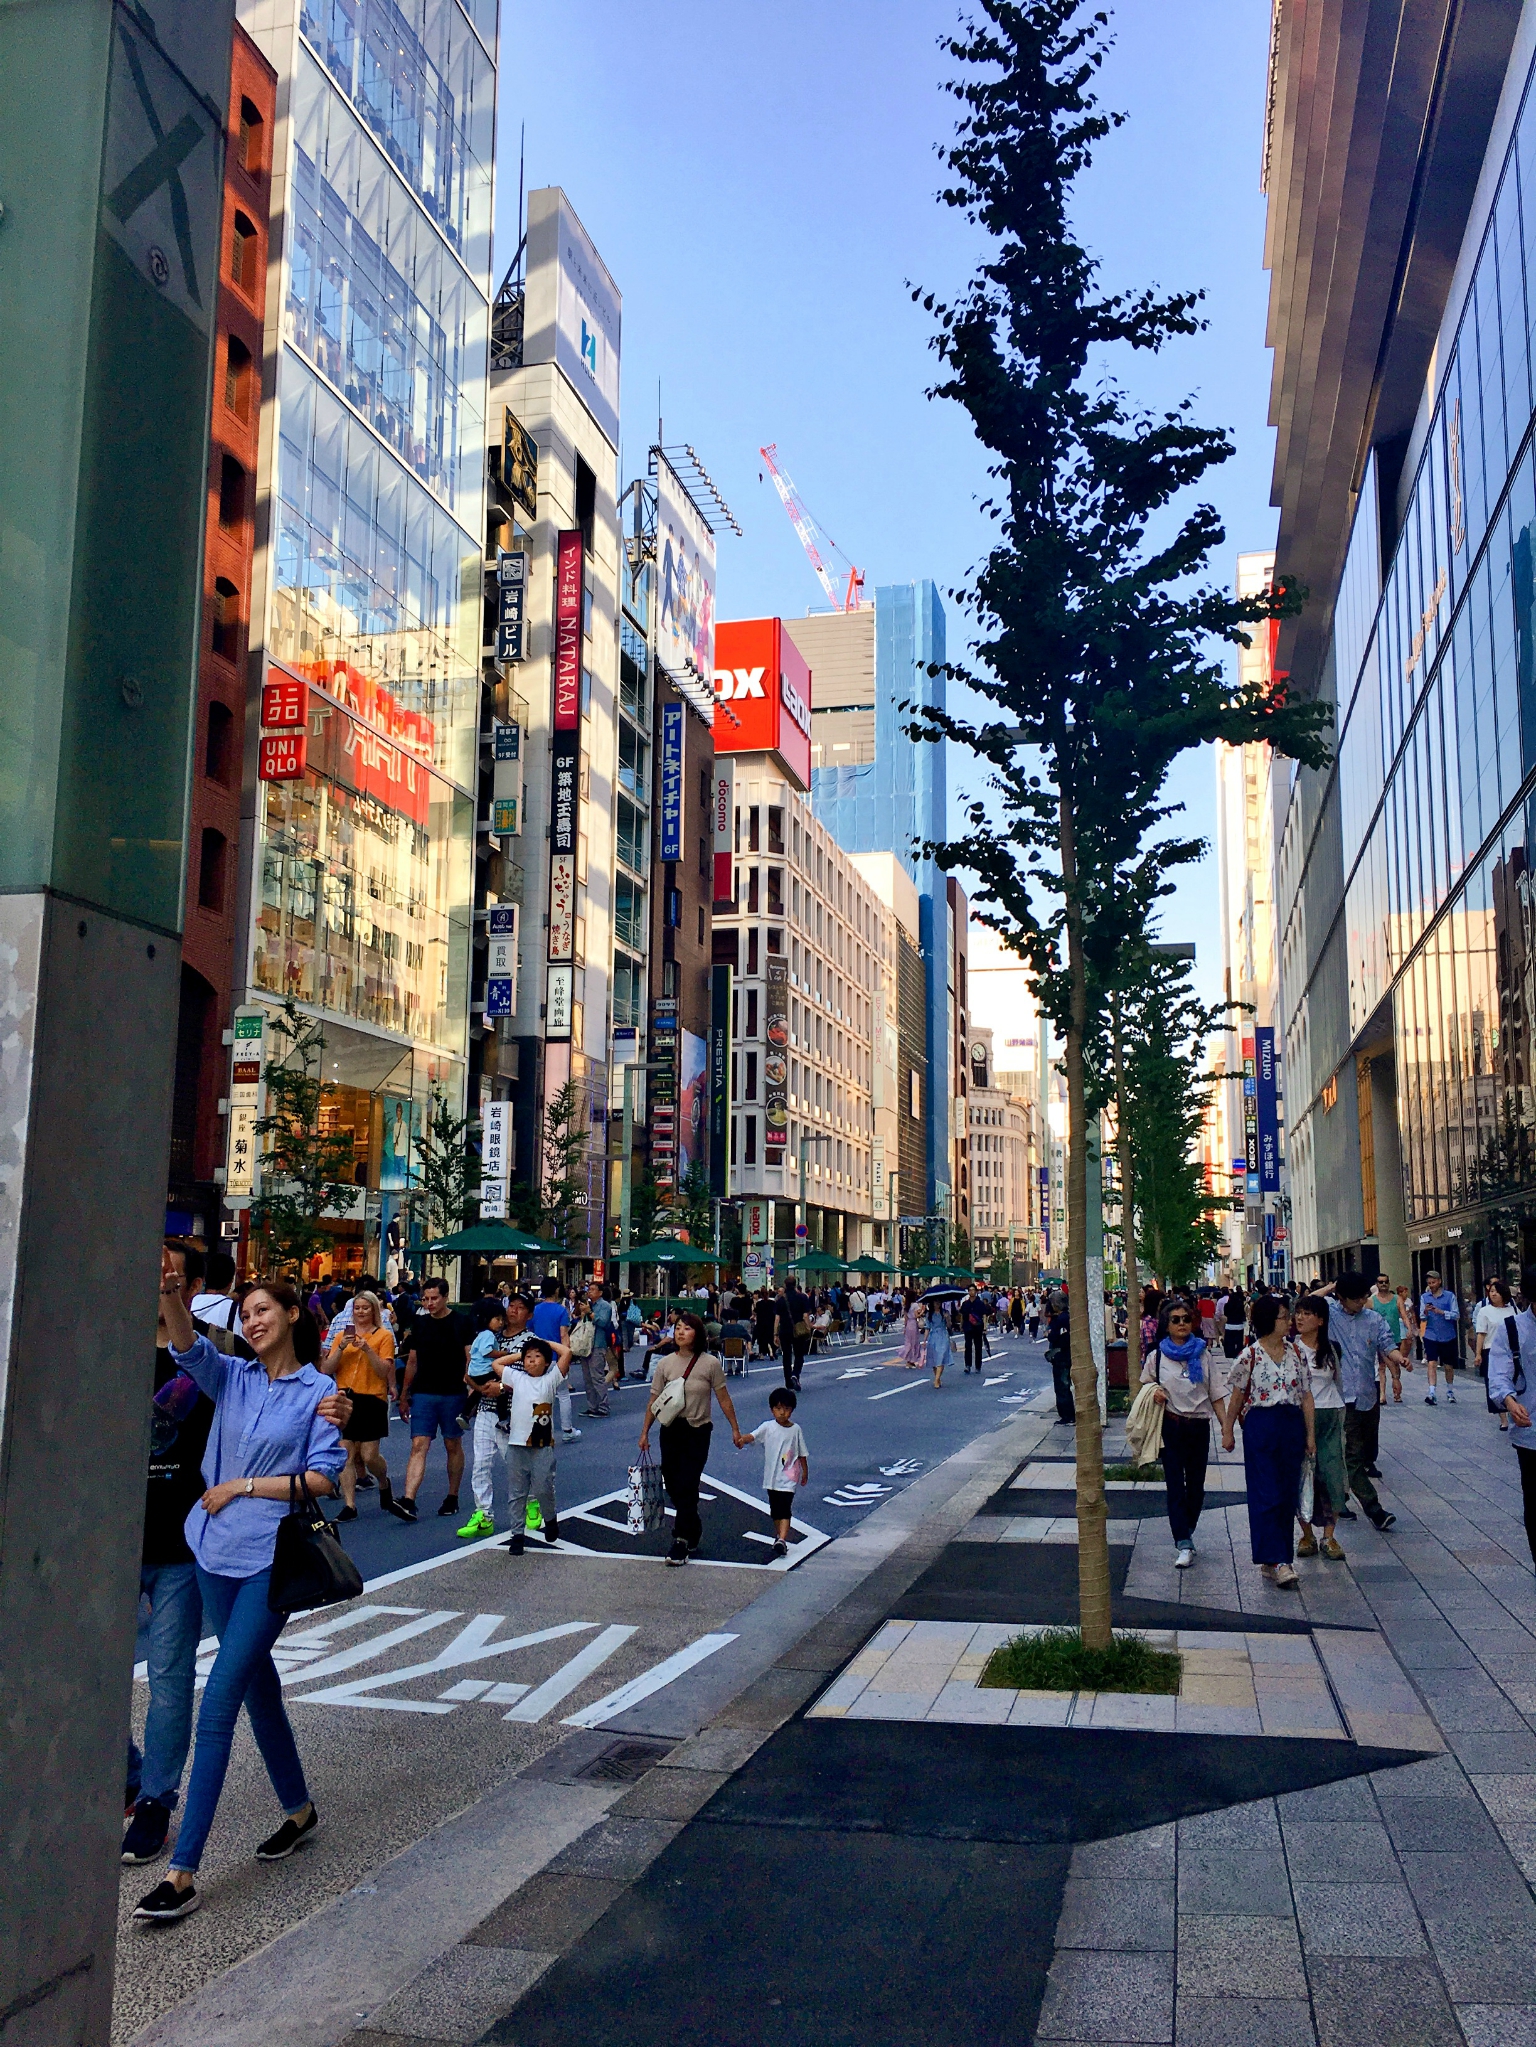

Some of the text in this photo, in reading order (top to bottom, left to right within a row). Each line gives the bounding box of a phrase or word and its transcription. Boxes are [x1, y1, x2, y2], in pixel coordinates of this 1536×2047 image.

[580, 357, 596, 387] HULIC
[502, 590, 519, 657] 岩崎ビル
[558, 546, 578, 716] インド料理 NATARAJ
[269, 687, 299, 704] ユニ
[267, 704, 298, 721] クロ
[266, 739, 295, 756] UNI
[556, 756, 575, 768] 6F
[265, 757, 297, 776] QLO
[663, 711, 682, 836] アートネイチャー
[718, 779, 729, 832] docomo
[664, 844, 679, 854] 6F
[551, 923, 561, 956] 焼き鳥
[561, 920, 571, 952] うなぎ
[495, 945, 507, 968] 買取
[490, 985, 510, 1007] 青山
[238, 1029, 260, 1037] セリナ
[1262, 1039, 1272, 1081] MIZUHO
[488, 1106, 502, 1172] 岩崎眼鏡店
[1248, 1138, 1256, 1170] GEOX
[233, 1138, 248, 1174] 菊水
[1264, 1134, 1275, 1179] みずほ銀行
